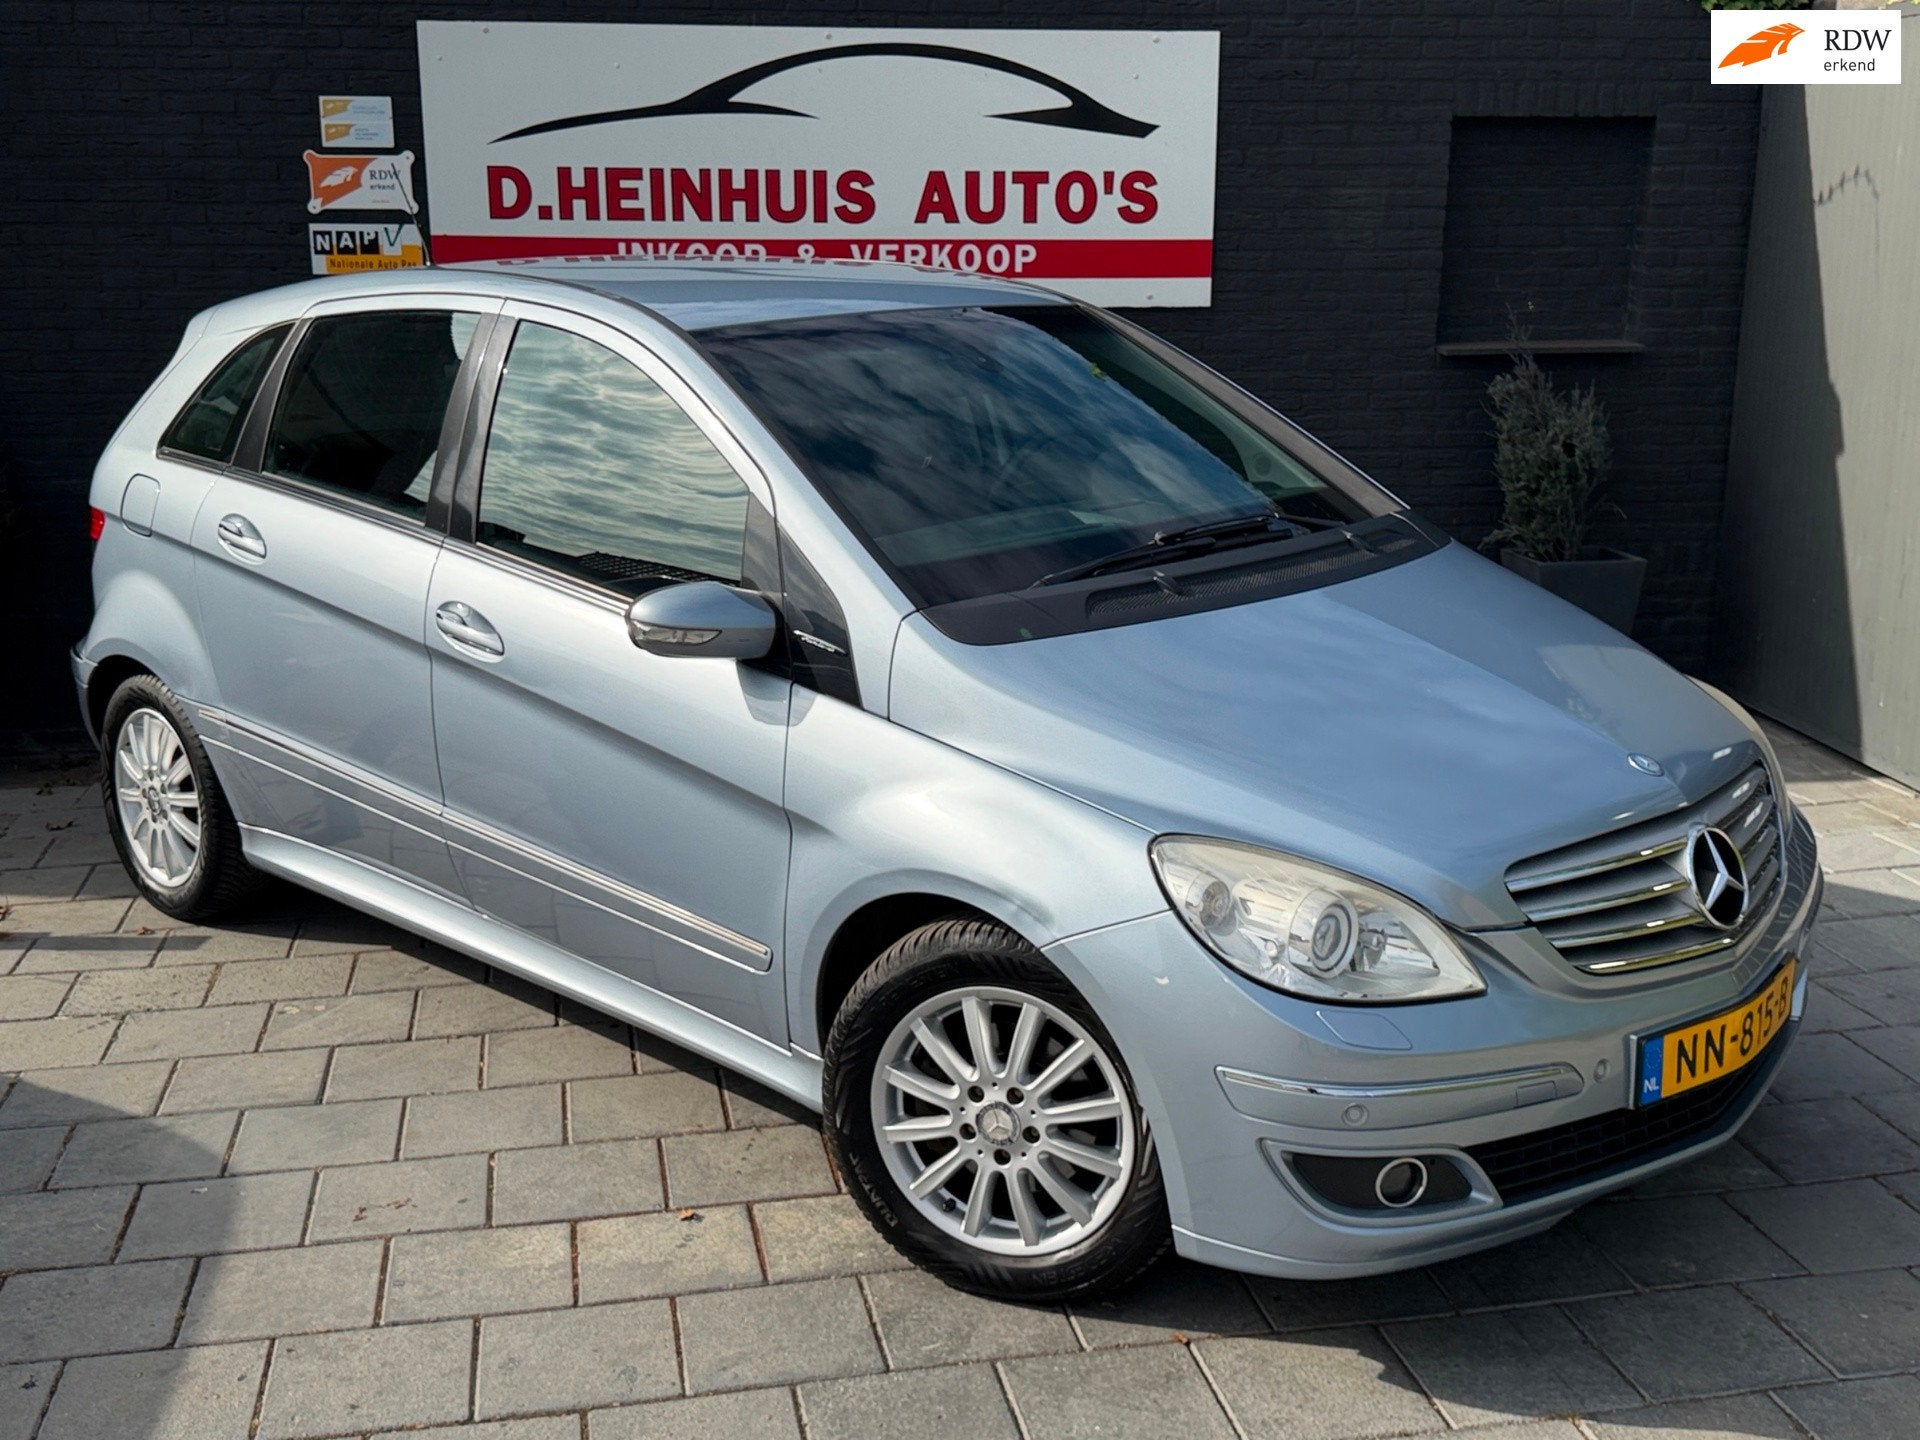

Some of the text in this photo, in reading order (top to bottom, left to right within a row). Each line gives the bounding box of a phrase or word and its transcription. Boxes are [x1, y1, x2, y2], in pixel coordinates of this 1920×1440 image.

[369, 169, 402, 180] RDW
[370, 182, 396, 190] erkend
[486, 165, 1159, 225] D.HEINHUIS AUTO'S
[329, 258, 375, 269] Nationale
[378, 259, 399, 269] Auto
[849, 243, 1038, 274] VERKOOP
[1675, 976, 1789, 1085] NN-815-B
[1643, 1076, 1660, 1093] NL
